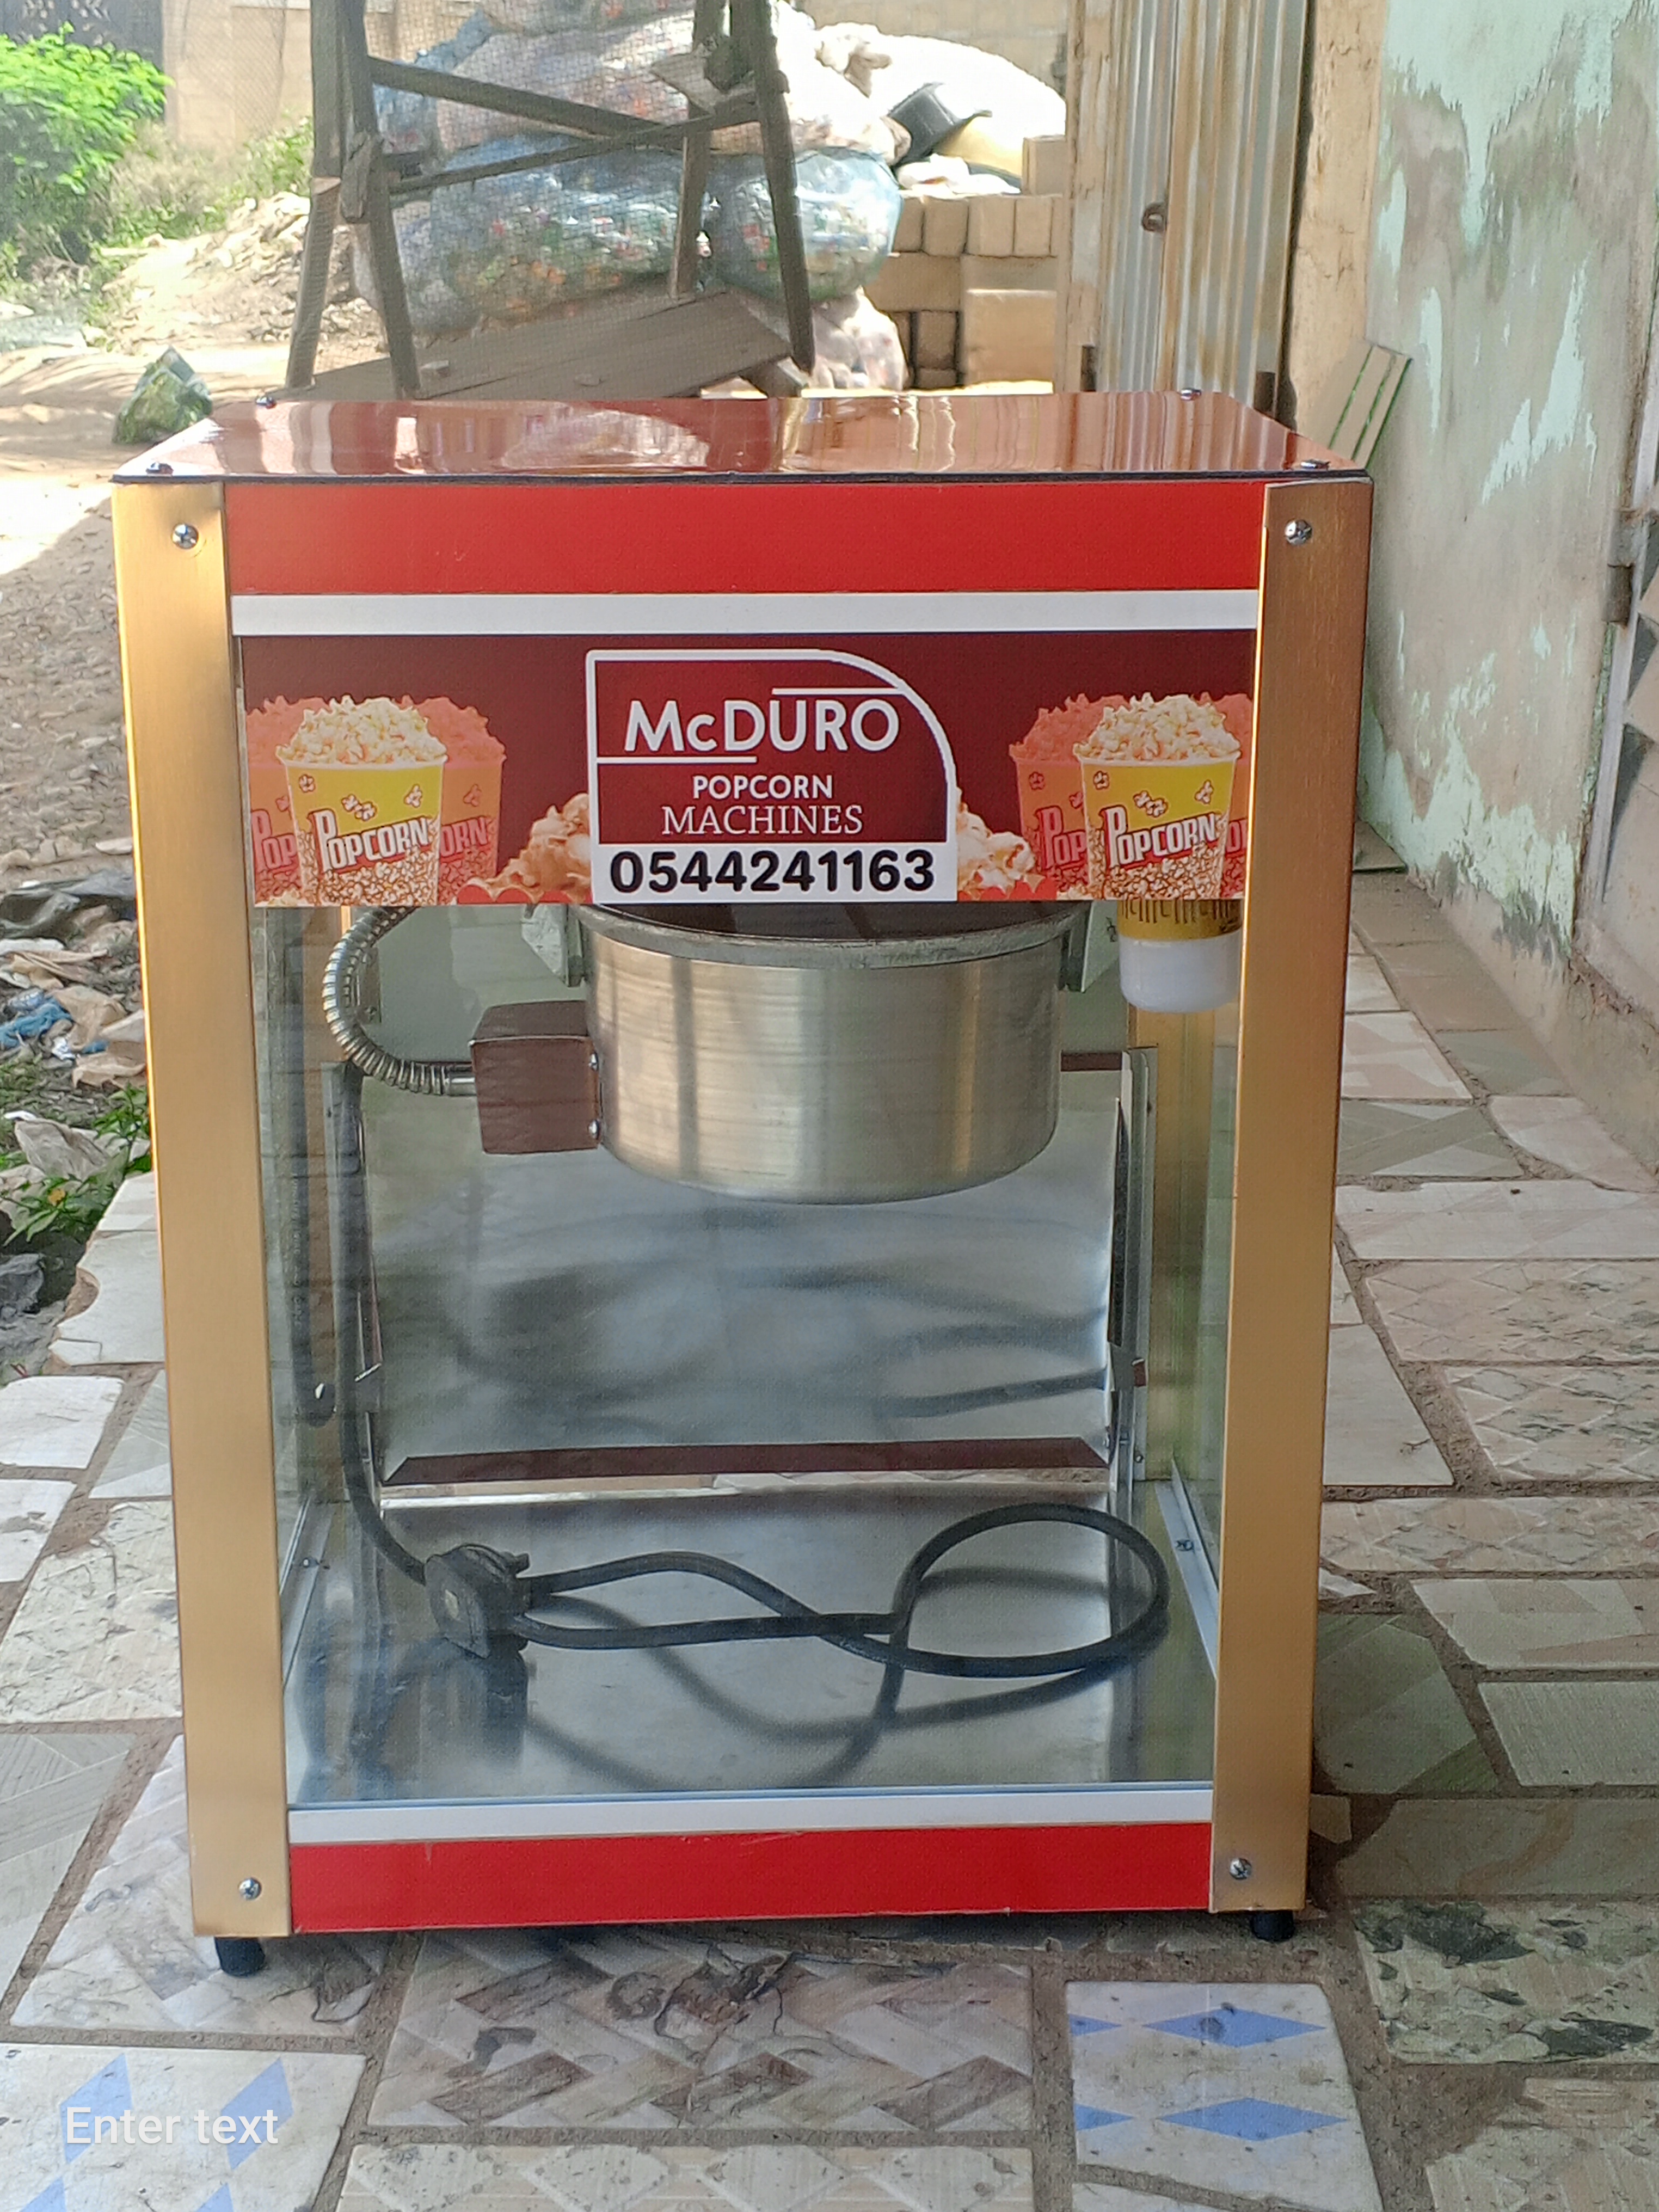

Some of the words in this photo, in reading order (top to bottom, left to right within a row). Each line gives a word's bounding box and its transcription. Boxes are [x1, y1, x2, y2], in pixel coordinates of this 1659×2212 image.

[624, 699, 900, 752] McDURO
[692, 775, 833, 800] POPCORN
[661, 804, 864, 835] MACHINES
[609, 849, 935, 893] 0544241163
